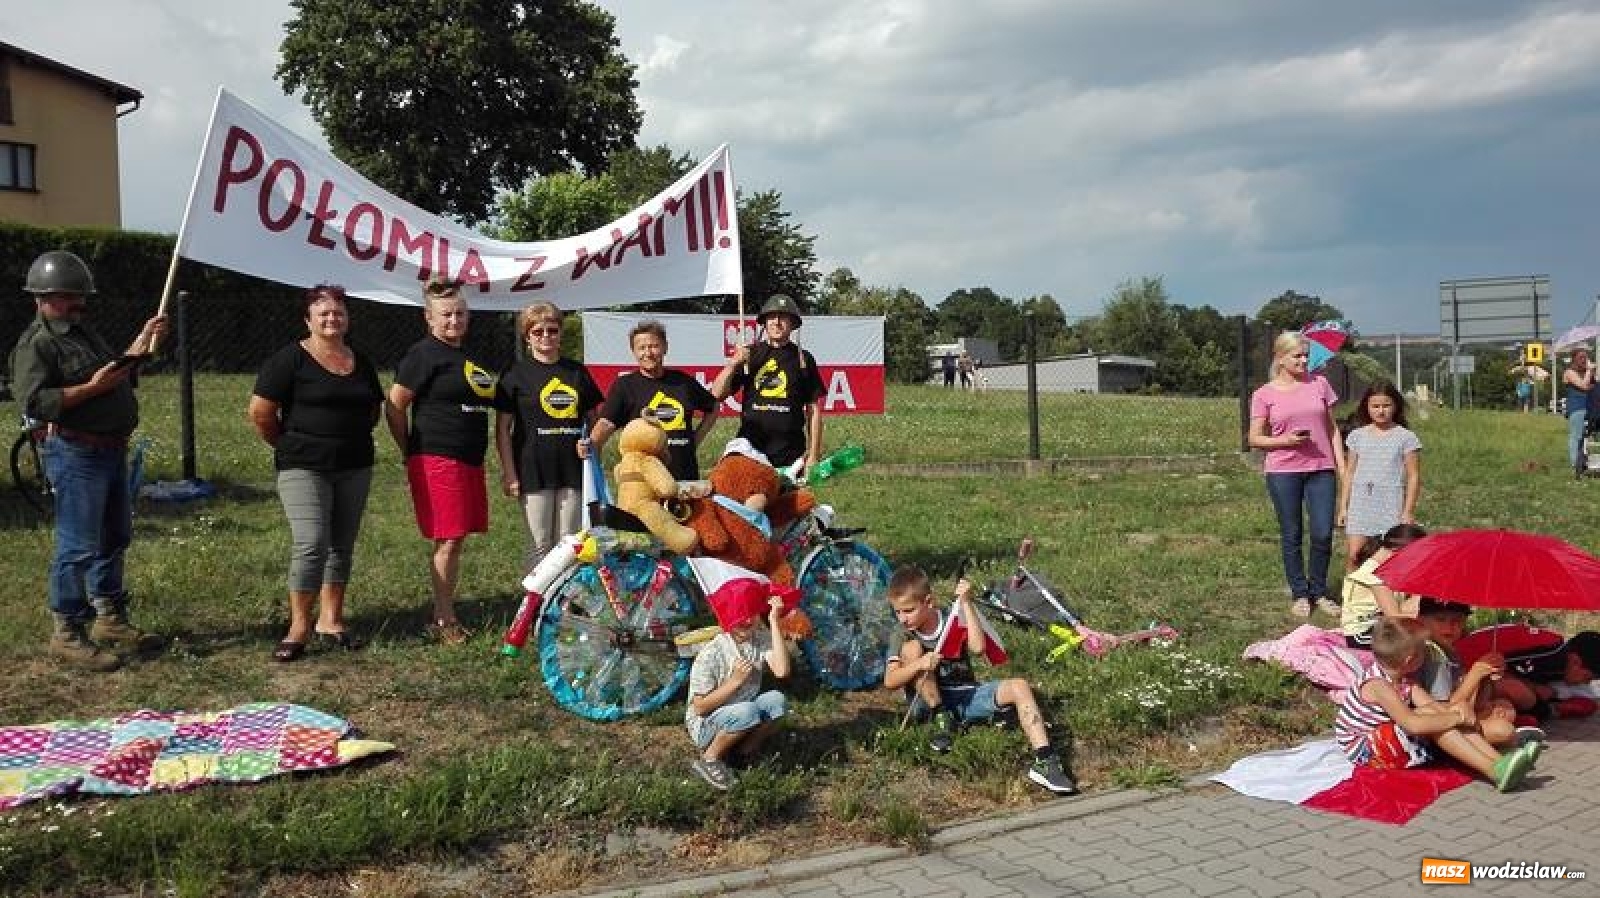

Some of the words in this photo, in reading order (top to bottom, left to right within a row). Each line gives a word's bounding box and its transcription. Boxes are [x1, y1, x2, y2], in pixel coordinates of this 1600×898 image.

[213, 125, 490, 293] POŁOMIA
[510, 255, 549, 292] Z
[571, 170, 731, 280] WAMI!
